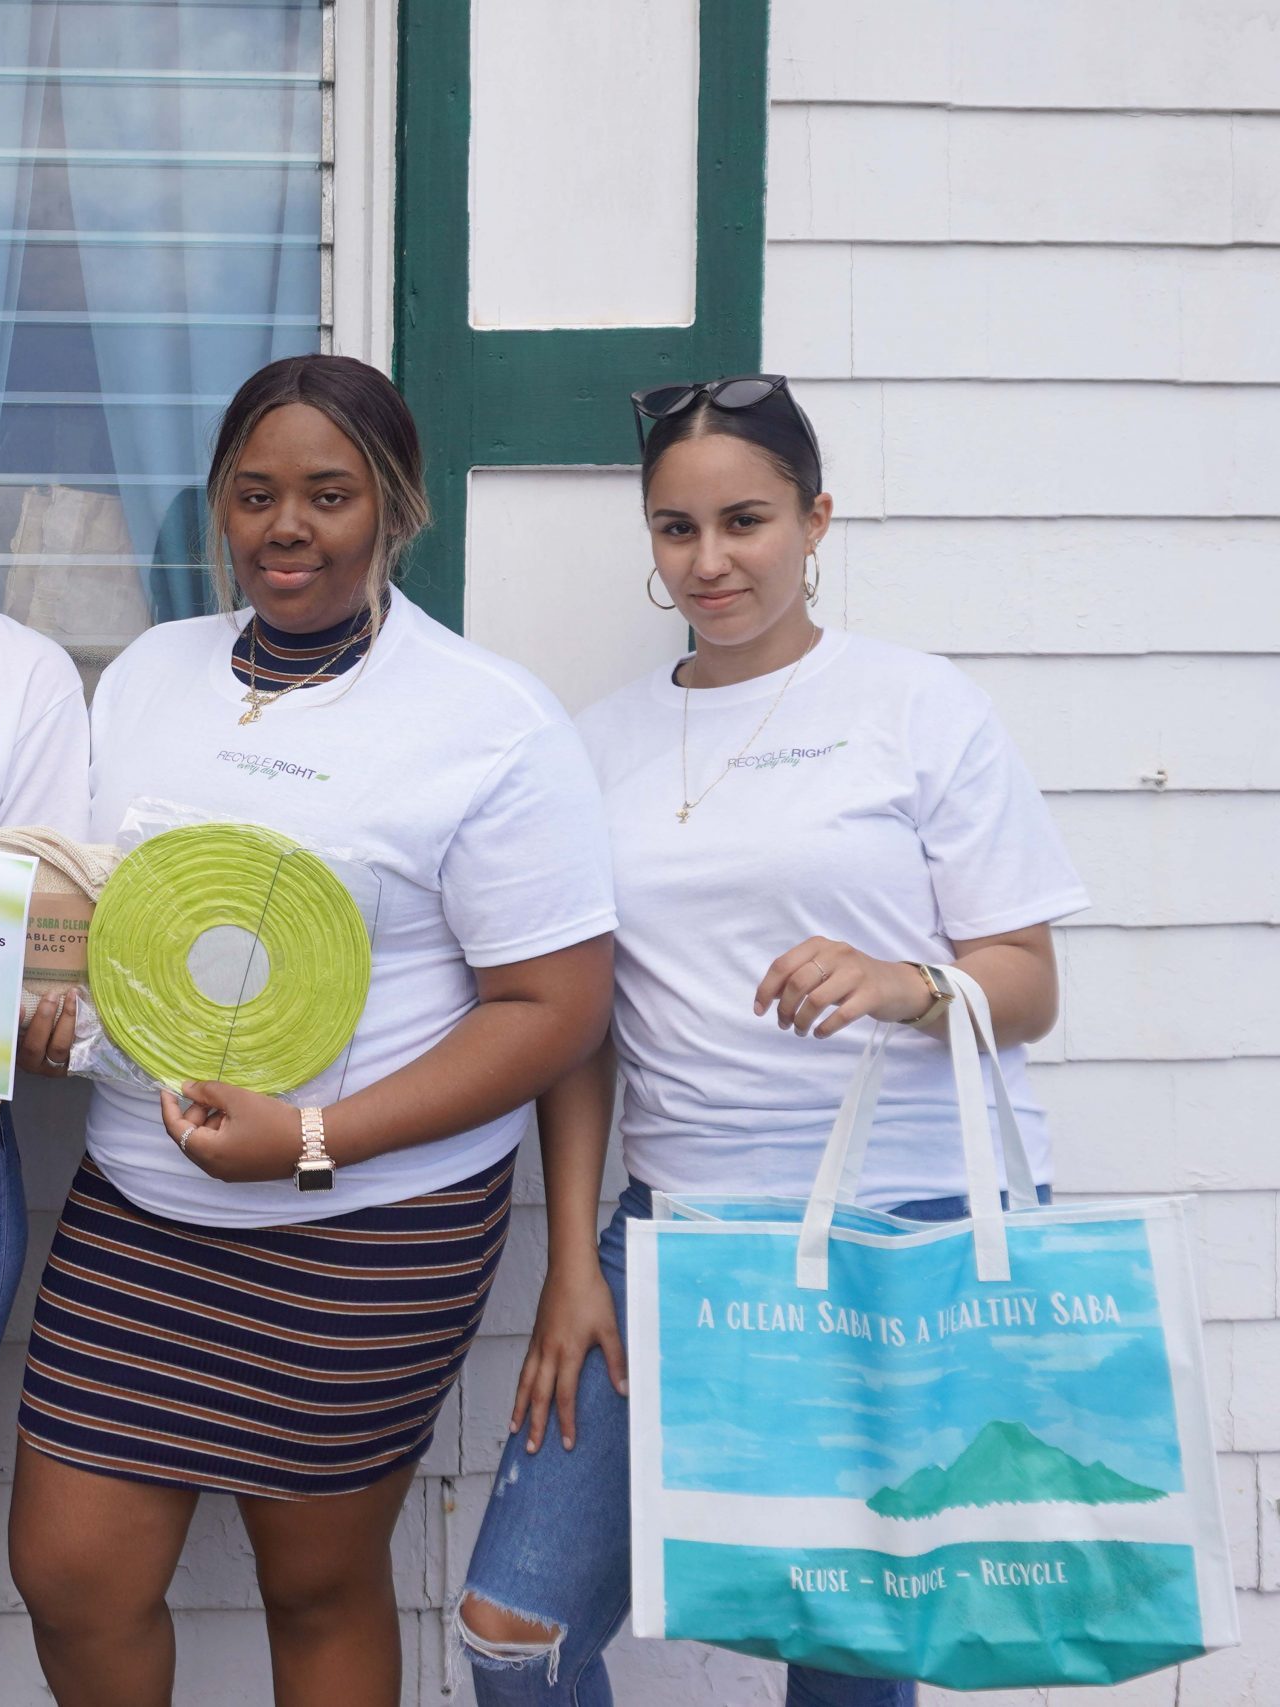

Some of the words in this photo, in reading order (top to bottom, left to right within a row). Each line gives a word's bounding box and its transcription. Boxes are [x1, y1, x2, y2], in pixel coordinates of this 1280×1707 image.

[217, 750, 272, 767] RECYCLE
[273, 760, 317, 780] RIGHT
[728, 749, 788, 768] RECYCLE
[791, 745, 834, 758] RIGHT
[34, 943, 65, 953] BAGS
[698, 1298, 715, 1329] A
[726, 1301, 805, 1332] CLEAN
[819, 1300, 873, 1343] SABA
[881, 1317, 906, 1347] IS
[918, 1325, 930, 1343] A
[938, 1297, 1038, 1338] HEALTHY
[1050, 1291, 1121, 1326] SABA
[790, 1565, 850, 1593] REUSE
[884, 1566, 948, 1599] REDUCE
[979, 1559, 1069, 1586] RECYCLE
